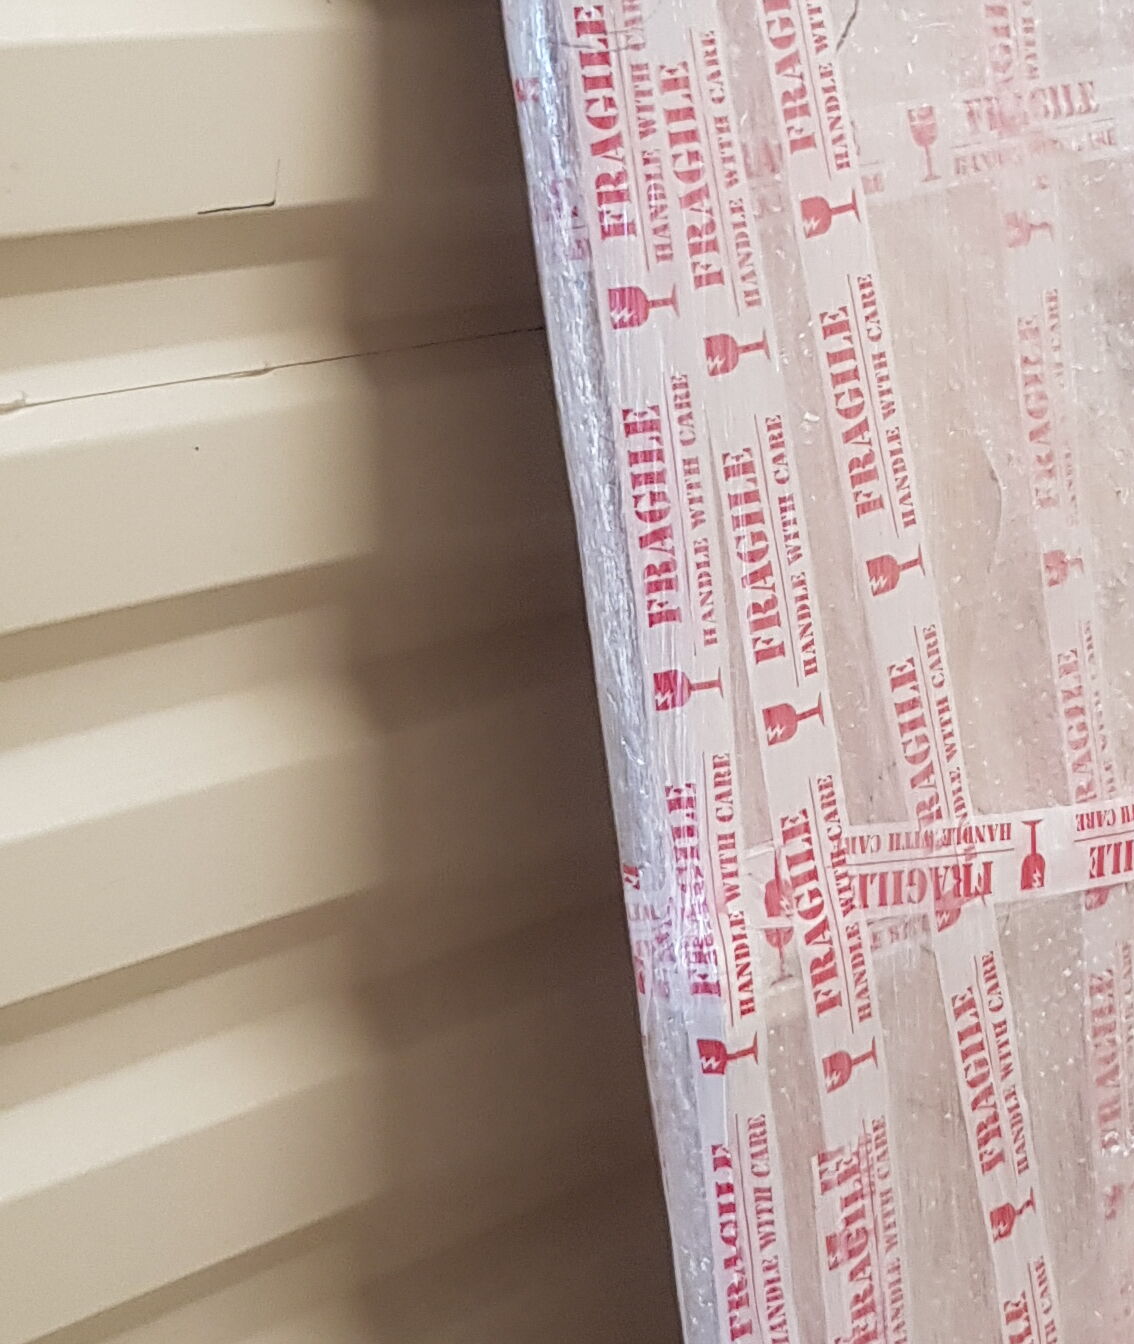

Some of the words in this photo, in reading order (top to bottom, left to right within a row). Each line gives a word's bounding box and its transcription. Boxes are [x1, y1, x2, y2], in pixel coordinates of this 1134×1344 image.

[631, 63, 657, 140] WITH
[701, 30, 725, 104] CARE
[573, 5, 637, 240] FRAGILE
[714, 116, 739, 188] WITH
[818, 63, 851, 170] HANDLE
[641, 149, 673, 264] HANDLE
[659, 60, 726, 290] FRAGILE
[729, 198, 762, 308] HANDLE
[857, 274, 883, 343] CARE
[671, 375, 696, 446] CARE
[819, 306, 885, 519] FRAGILE
[872, 352, 897, 420] WITH
[765, 415, 790, 485] CARE
[885, 426, 917, 528] HANDLE
[621, 405, 682, 628] FRAGILE
[681, 458, 707, 529] WITH
[778, 495, 803, 565] WITH
[694, 538, 719, 646] HANDLE
[722, 447, 786, 664] FRAGILE
[791, 572, 818, 676] HANDLE
[922, 624, 945, 688] CARE
[935, 696, 958, 761] WITH
[712, 753, 736, 822] CARE
[1076, 808, 1118, 832] CARE
[714, 831, 740, 904] WITH
[780, 809, 843, 1017] FRAGILE
[729, 910, 757, 1017] HANDLE
[846, 921, 873, 1022] HANDLE
[982, 951, 1004, 1012] CARE
[950, 986, 1005, 1176] FRAGILE
[992, 1021, 1013, 1080] WITH
[747, 1114, 769, 1177] CARE
[1004, 1086, 1030, 1175] HANDLE
[754, 1187, 777, 1251] WITH
